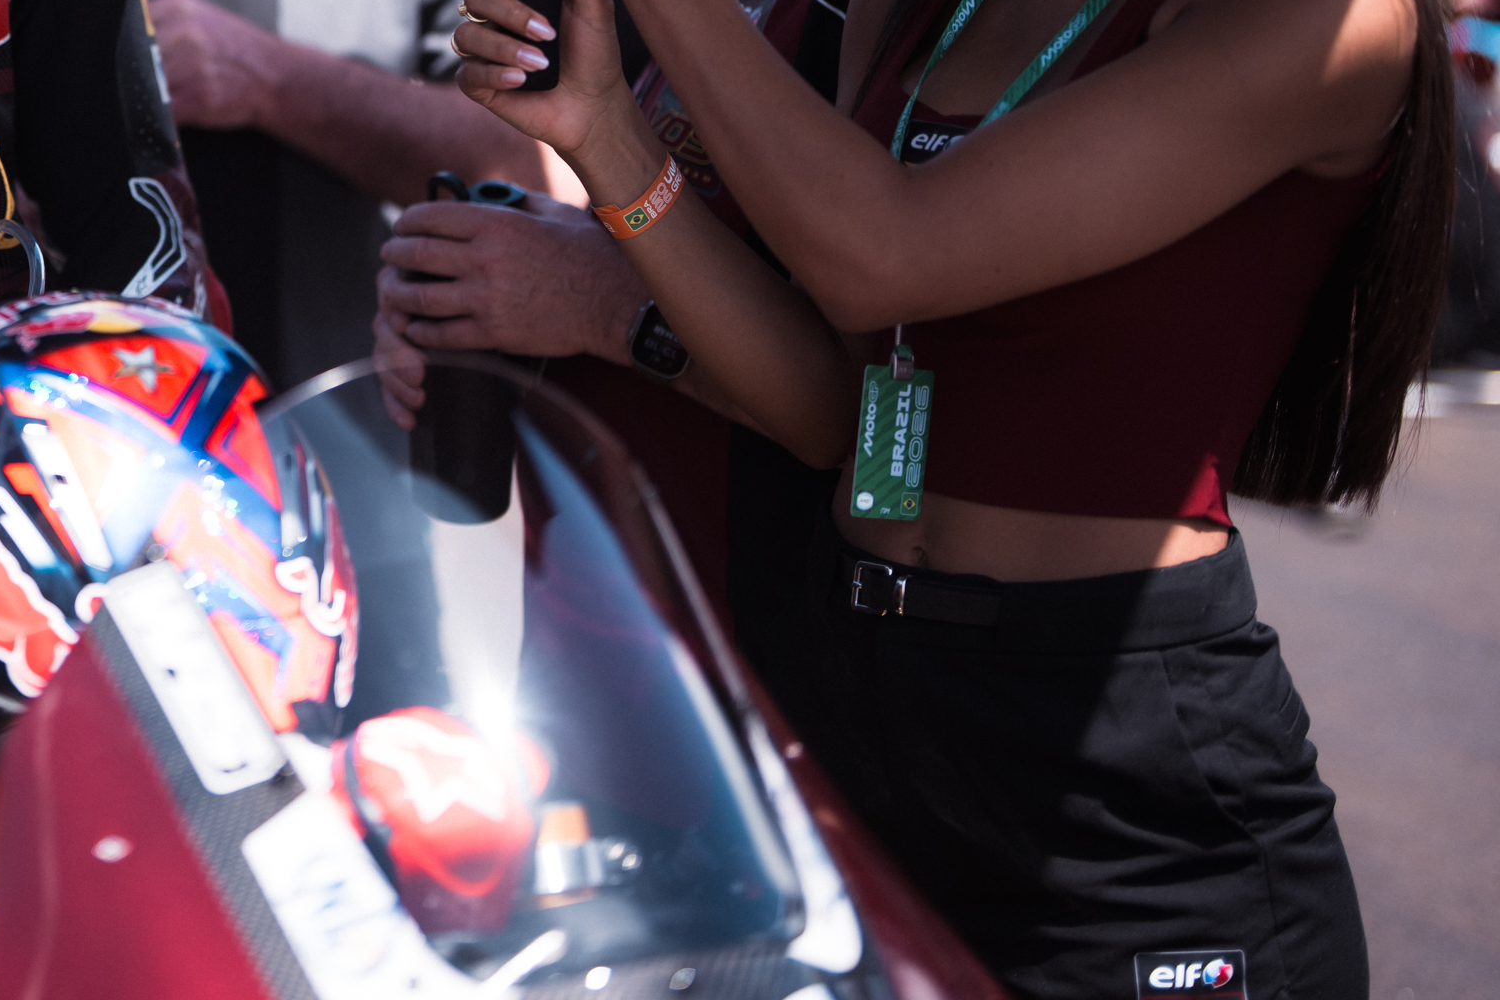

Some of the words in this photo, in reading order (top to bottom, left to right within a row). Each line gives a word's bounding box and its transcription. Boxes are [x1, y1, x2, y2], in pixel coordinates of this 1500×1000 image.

[910, 132, 948, 152] elf
[643, 199, 658, 219] BRA
[863, 380, 879, 458] MotoGP
[890, 384, 912, 477] BRAZIL
[905, 385, 929, 487] 2026
[1149, 961, 1203, 989] elf
